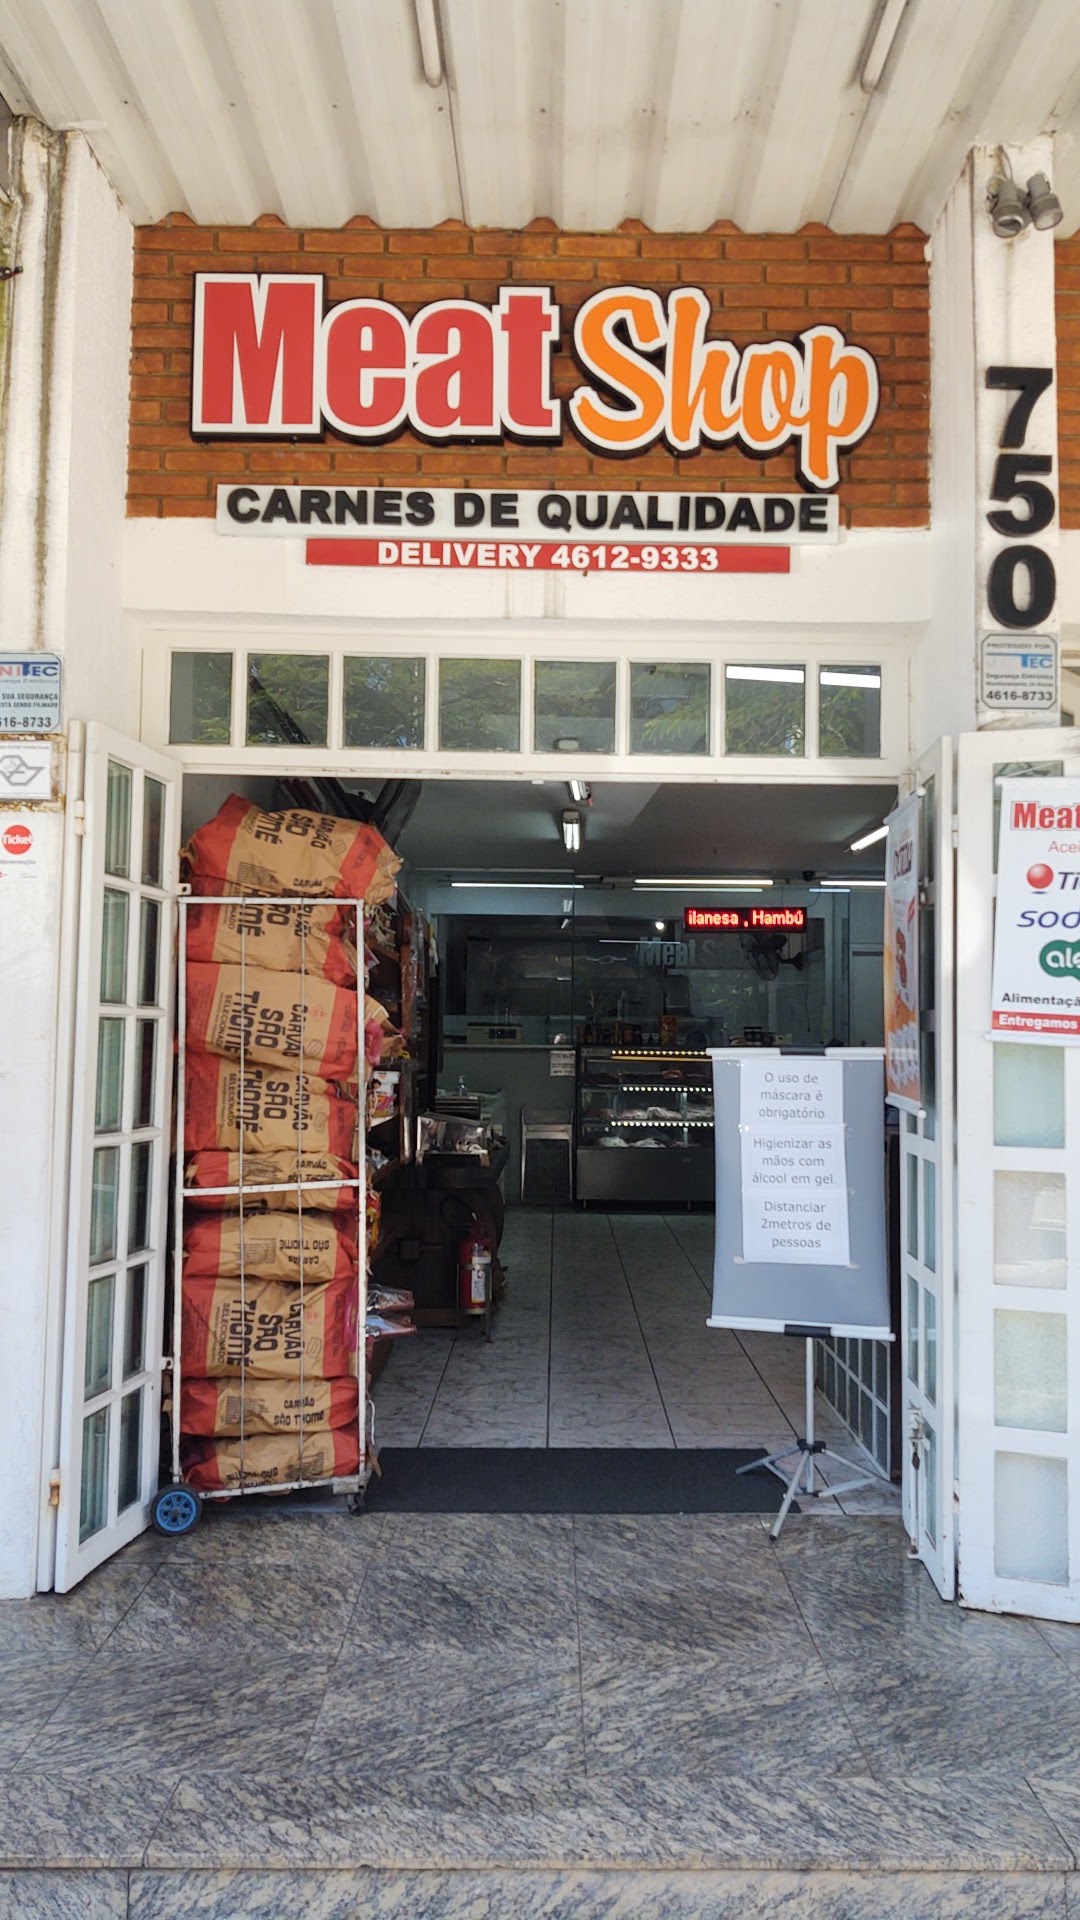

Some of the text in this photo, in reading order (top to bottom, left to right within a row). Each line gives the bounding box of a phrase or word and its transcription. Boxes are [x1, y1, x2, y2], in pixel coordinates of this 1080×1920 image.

[195, 273, 878, 487] Meat Shop
[227, 488, 829, 533] CARNES DE QUALIDADE
[985, 366, 1056, 629] 750
[378, 541, 719, 571] DELIVERY 4612-9333
[17, 693, 58, 701] SEGURANÇA
[986, 691, 1053, 701] 4616-8733
[285, 812, 314, 837] SÃO
[311, 817, 337, 850] CARVÃO
[2, 833, 33, 846] Ticket
[752, 910, 803, 925] Hambú
[224, 991, 260, 1058] THOMÉ
[255, 1008, 286, 1049] SÃO
[282, 1003, 309, 1058] CARVÃO
[999, 1013, 1078, 1030] Entregamos
[764, 1072, 819, 1084] O uso de
[226, 1073, 236, 1127] SELECIONADO
[235, 1070, 263, 1133] THOMÉ
[264, 1081, 293, 1119] SÃO
[292, 1074, 313, 1131] CARVÃO
[760, 1089, 823, 1101] máscara é
[758, 1107, 825, 1120] obrigatório
[753, 1138, 832, 1151] Higienizar as
[762, 1155, 825, 1167] mãos com
[752, 1171, 788, 1184] álcool
[791, 1175, 811, 1184] em
[764, 1201, 826, 1213] Distanciar
[761, 1218, 831, 1231] 2metros de
[771, 1238, 821, 1248] pessoas
[217, 1303, 232, 1364] SELECIONADO
[226, 1299, 258, 1367] THOMÉ
[254, 1314, 284, 1351] SÃO
[284, 1303, 305, 1360] CARVÃO
[273, 1412, 292, 1426] SÃO
